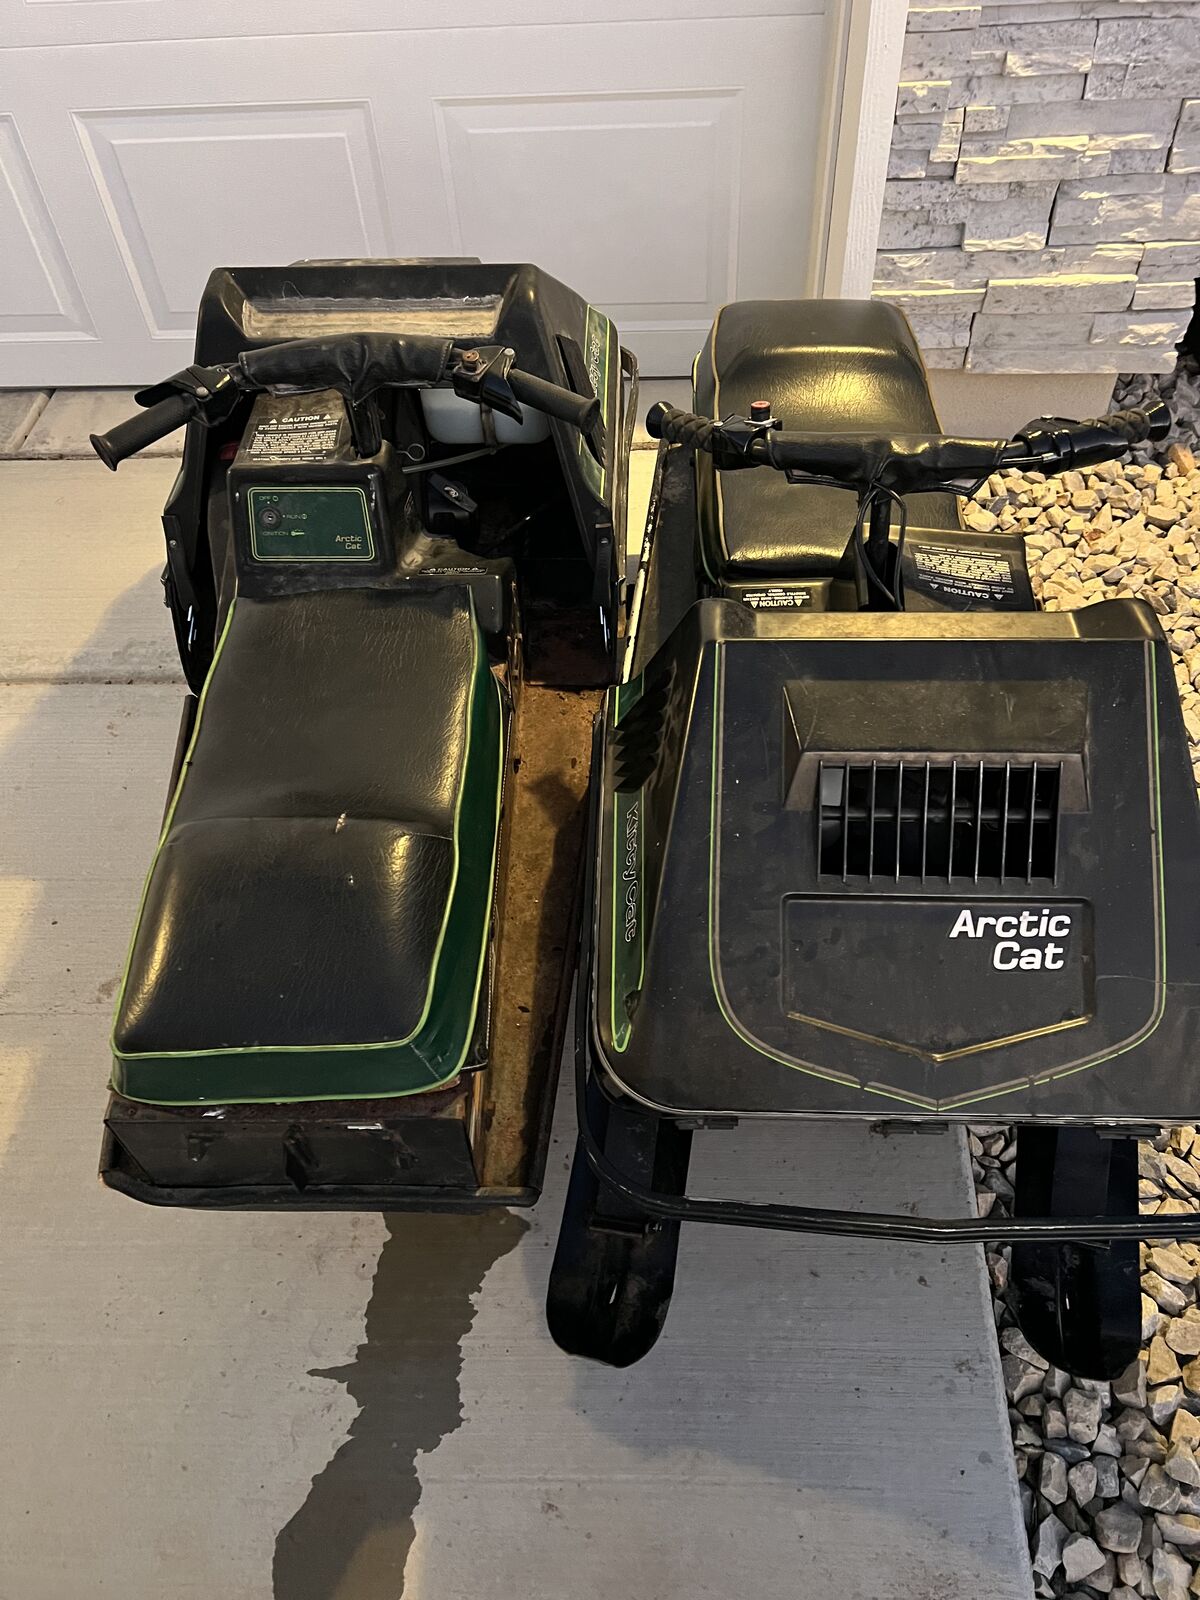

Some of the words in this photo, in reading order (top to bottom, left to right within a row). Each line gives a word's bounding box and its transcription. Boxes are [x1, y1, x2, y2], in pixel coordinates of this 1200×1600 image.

[282, 415, 320, 423] CAUTION
[335, 535, 363, 543] Arctic
[759, 599, 794, 607] CAUTION
[943, 586, 990, 599] CAUTION
[622, 801, 639, 881] Kitty
[624, 880, 639, 942] Cat
[949, 908, 1071, 938] Arctic
[993, 940, 1065, 970] Cat
